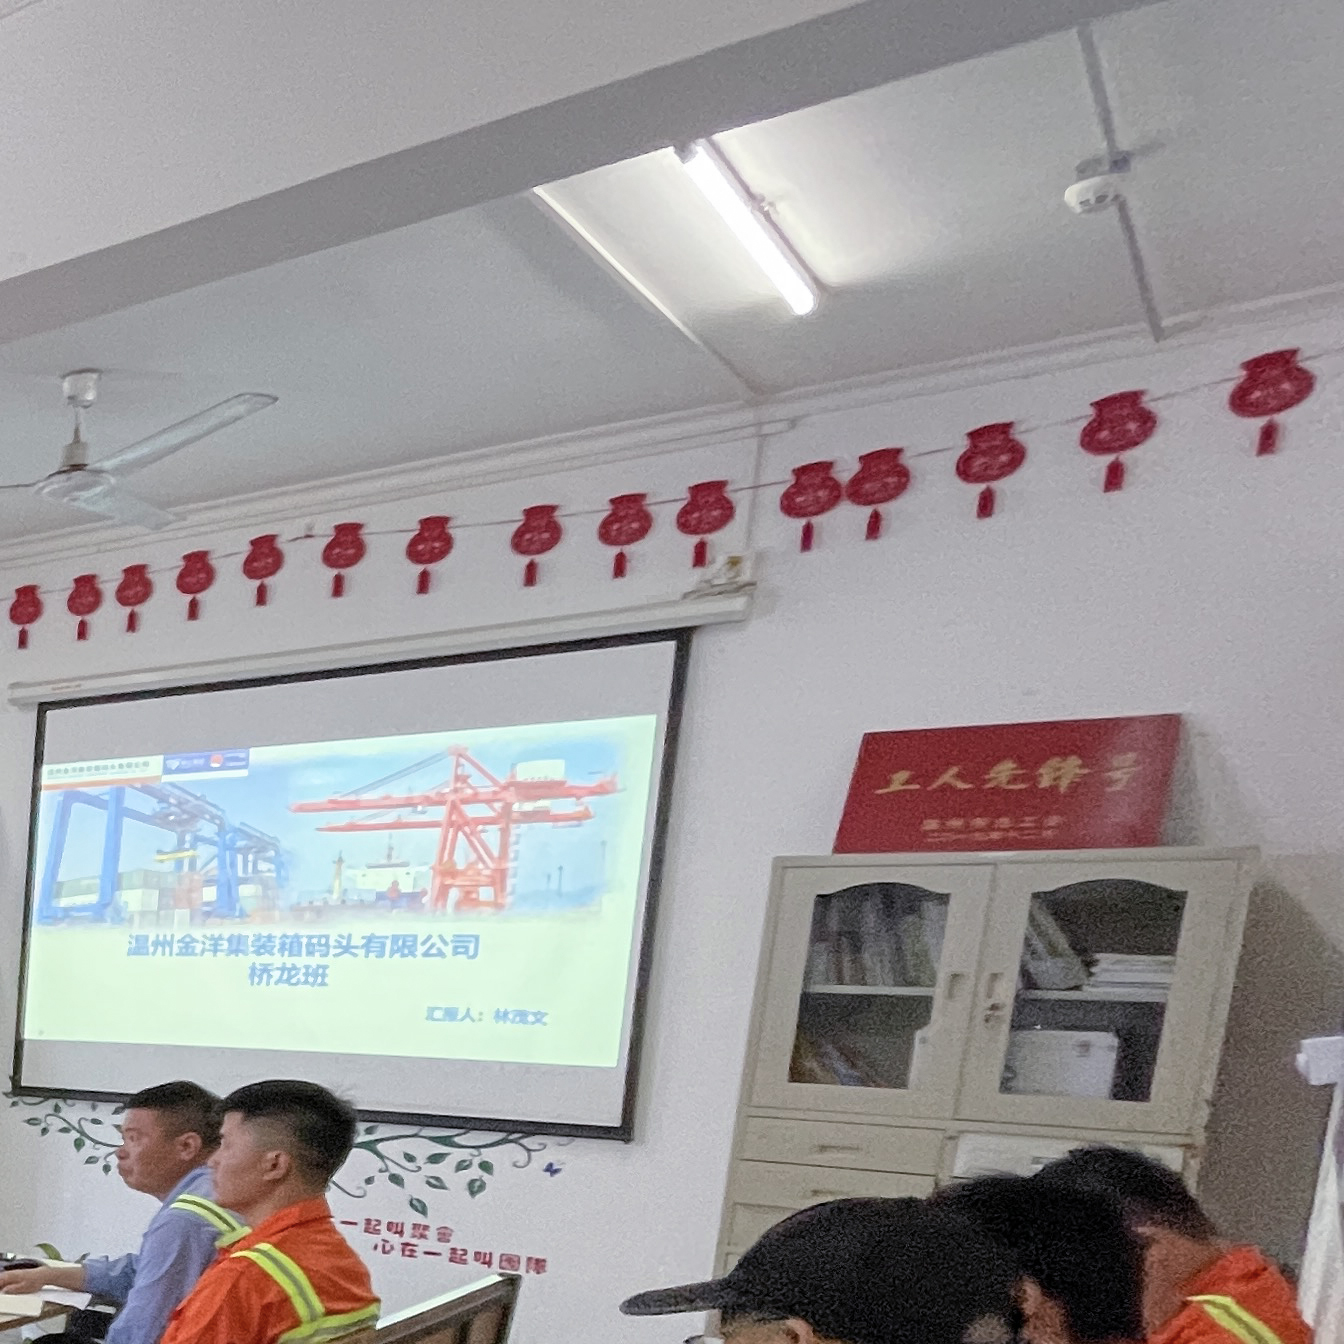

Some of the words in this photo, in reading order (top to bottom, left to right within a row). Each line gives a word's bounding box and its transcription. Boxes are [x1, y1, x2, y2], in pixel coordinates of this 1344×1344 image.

[127, 933, 481, 959] 温州金洋集装箱码头有限公司
[248, 962, 330, 987] 桥龙班
